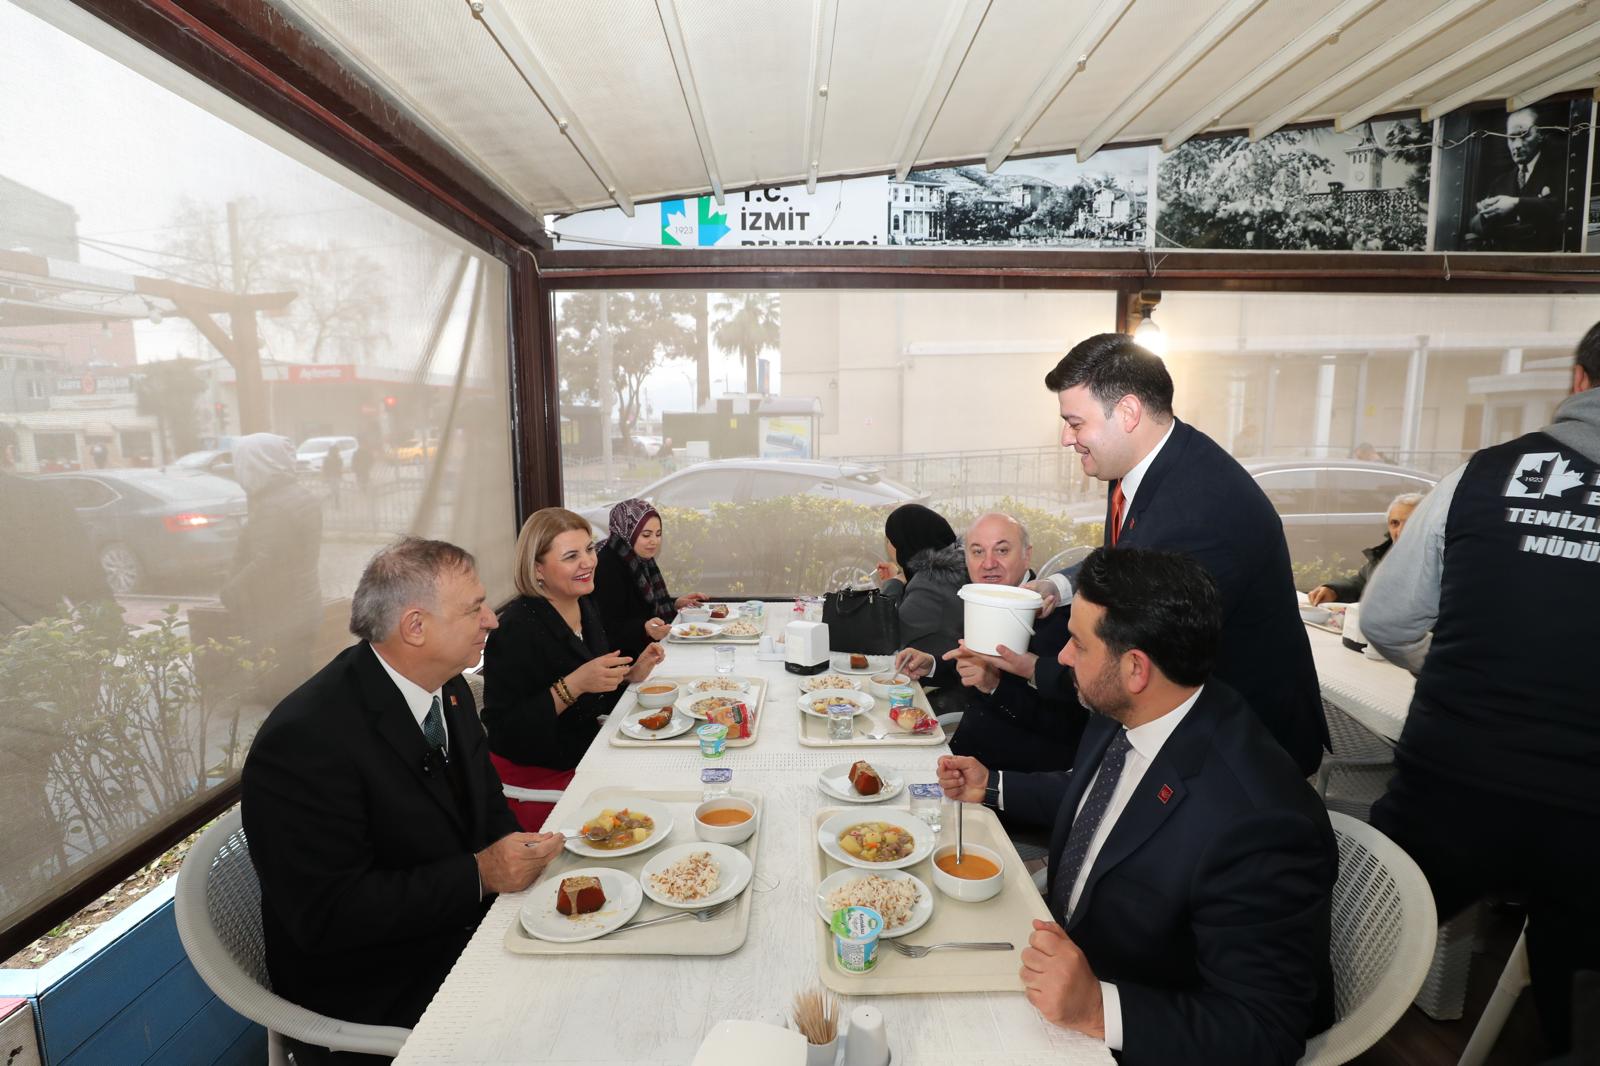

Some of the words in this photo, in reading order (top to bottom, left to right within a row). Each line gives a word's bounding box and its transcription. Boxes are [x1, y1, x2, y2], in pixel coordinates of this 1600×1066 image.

[674, 226, 694, 234] 1923
[741, 207, 810, 231] İZMİT
[1508, 507, 1600, 534] TEMİZL
[1523, 535, 1600, 563] MÜDÜ
